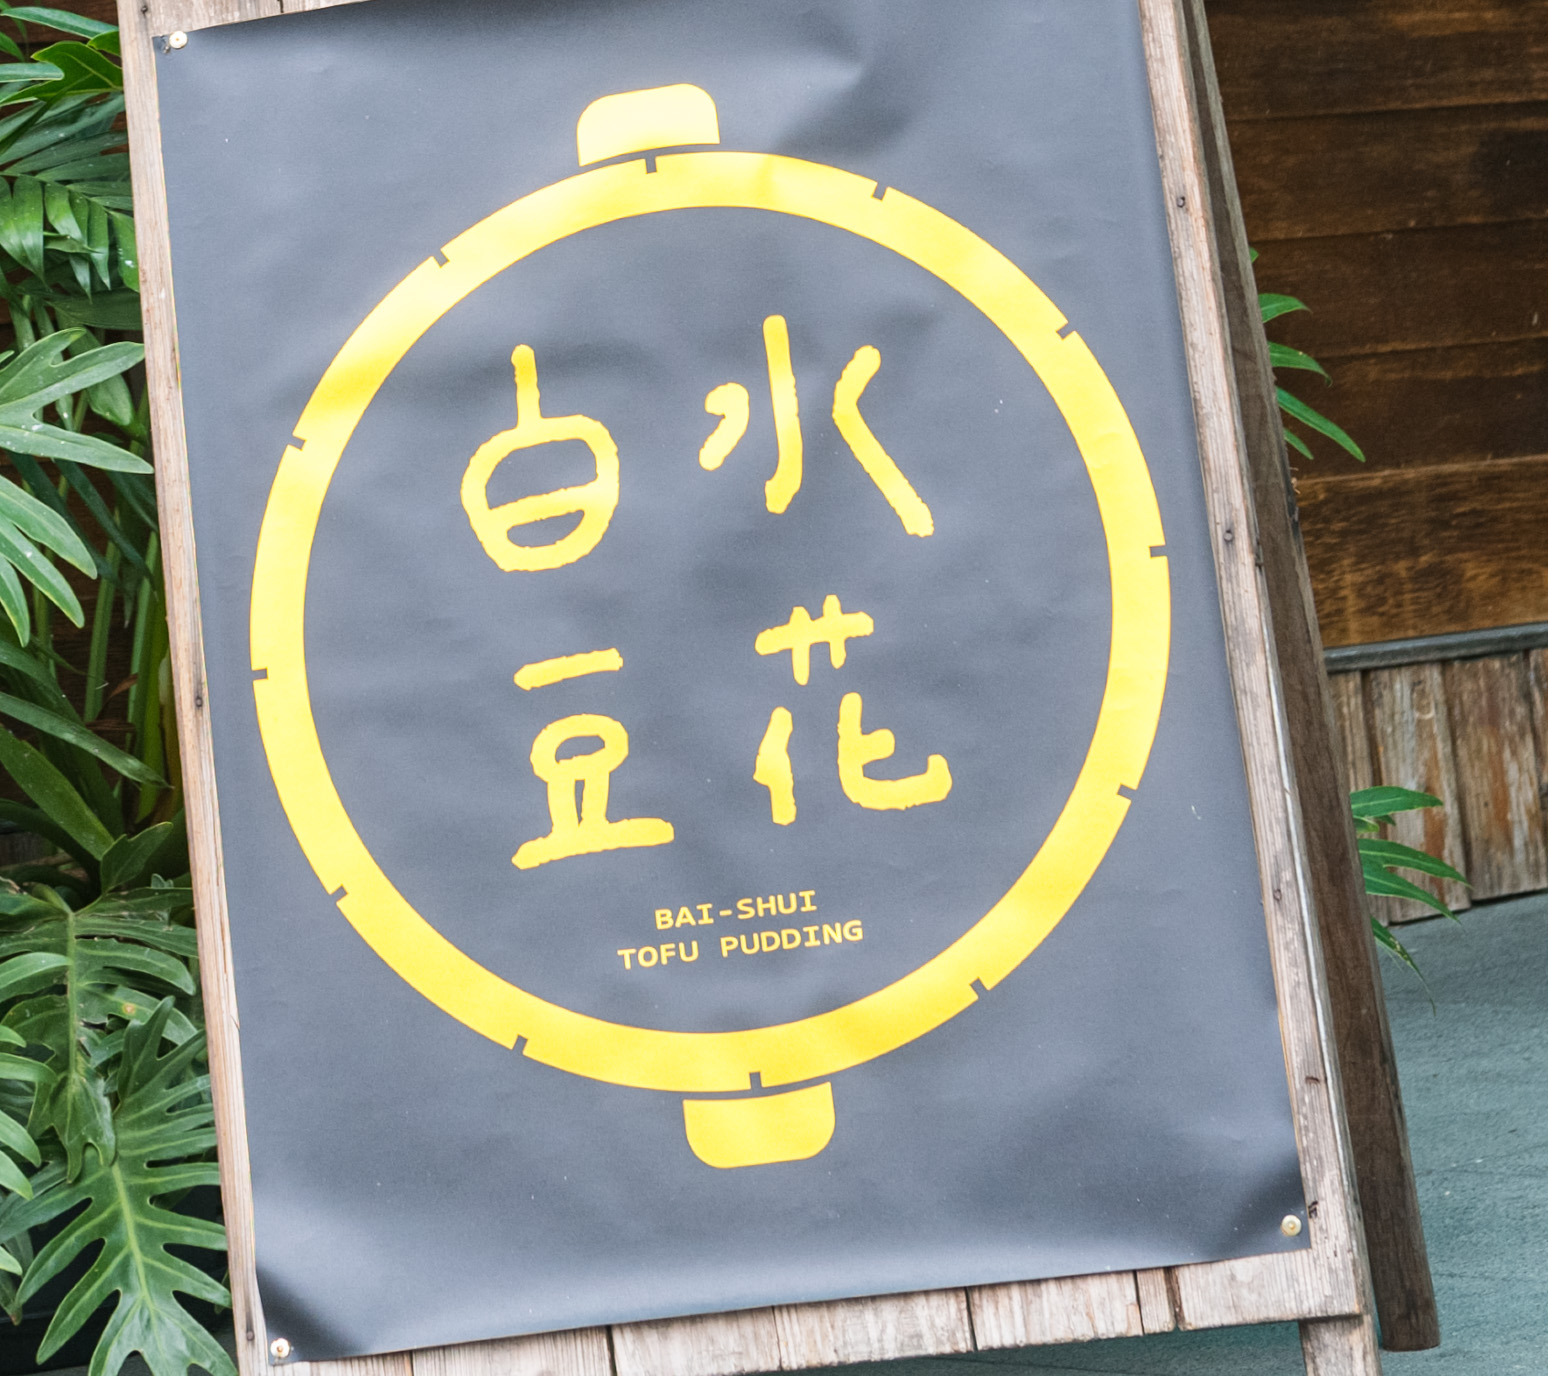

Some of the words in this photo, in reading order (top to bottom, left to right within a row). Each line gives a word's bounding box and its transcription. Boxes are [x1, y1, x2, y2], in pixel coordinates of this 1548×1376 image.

[459, 314, 934, 573] 白水
[510, 593, 953, 870] 豆花
[616, 939, 700, 970] TOFU
[719, 919, 864, 958] PUDDING
[654, 889, 818, 931] BAI-SHUI
